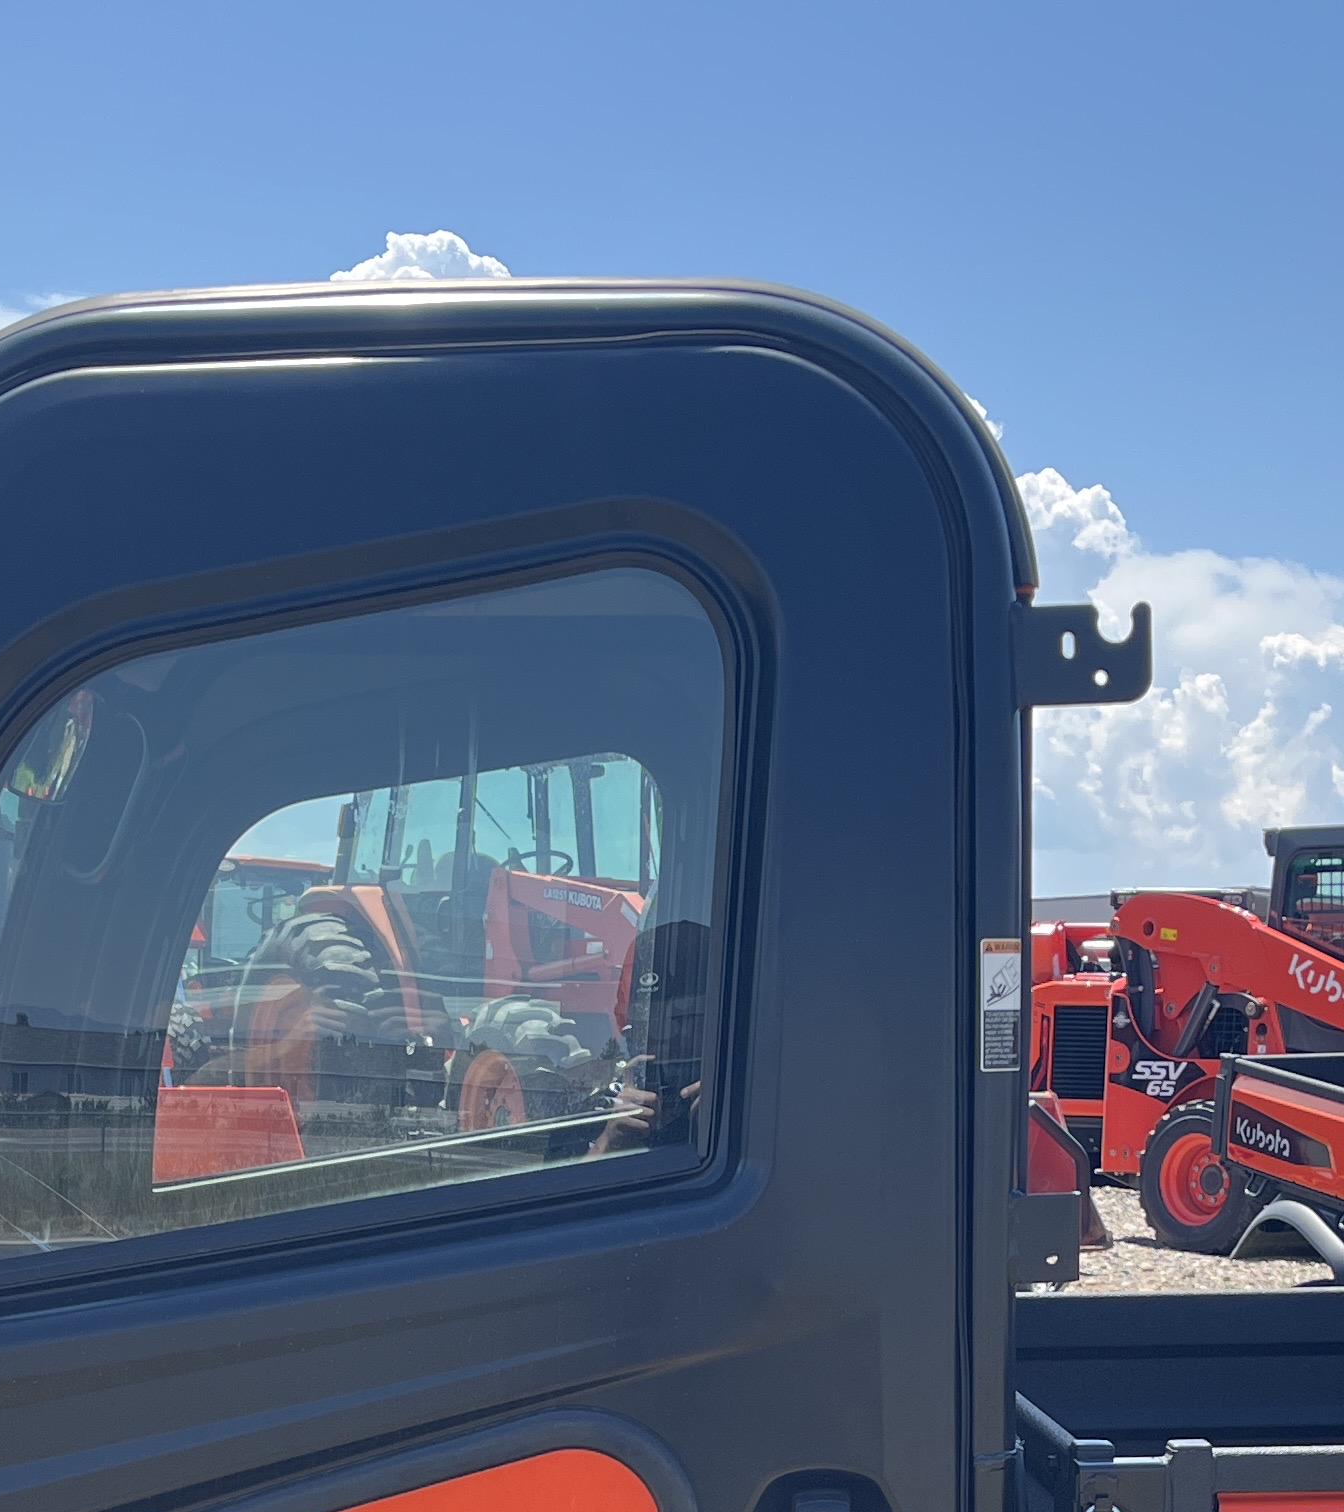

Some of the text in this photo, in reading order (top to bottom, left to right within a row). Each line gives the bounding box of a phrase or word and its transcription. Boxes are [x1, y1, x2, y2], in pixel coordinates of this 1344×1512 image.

[568, 891, 602, 911] KUBOTA
[1132, 1060, 1188, 1080] SSV
[1146, 1080, 1177, 1097] 65
[1235, 1116, 1291, 1158] Kubota
